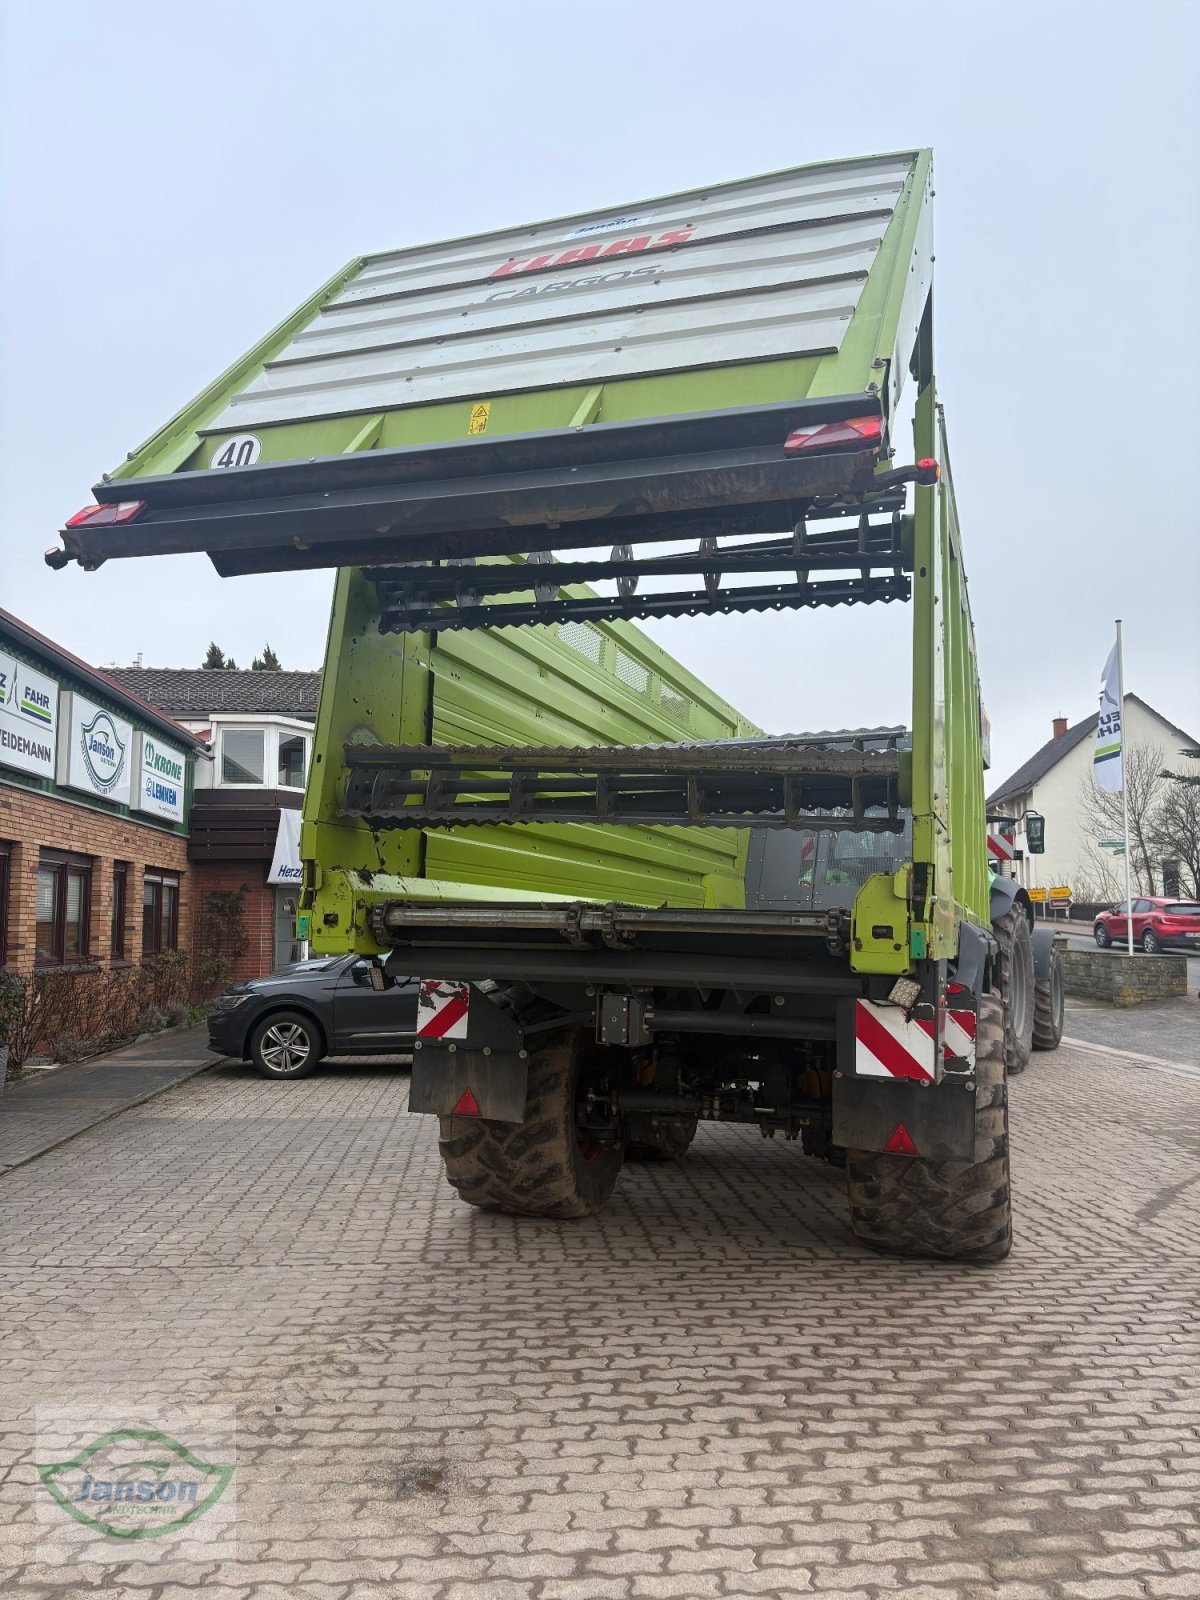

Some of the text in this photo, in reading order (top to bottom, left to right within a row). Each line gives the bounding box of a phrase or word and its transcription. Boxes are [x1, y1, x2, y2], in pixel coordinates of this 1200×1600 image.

[490, 227, 697, 277] CLAAS
[485, 264, 662, 303] CARGOS
[217, 440, 254, 467] 40
[24, 686, 50, 709] FAHR
[0, 728, 51, 763] EIDEMANN
[88, 734, 115, 760] Janson
[154, 754, 182, 781] KRONE
[152, 781, 177, 806] LEMKEN
